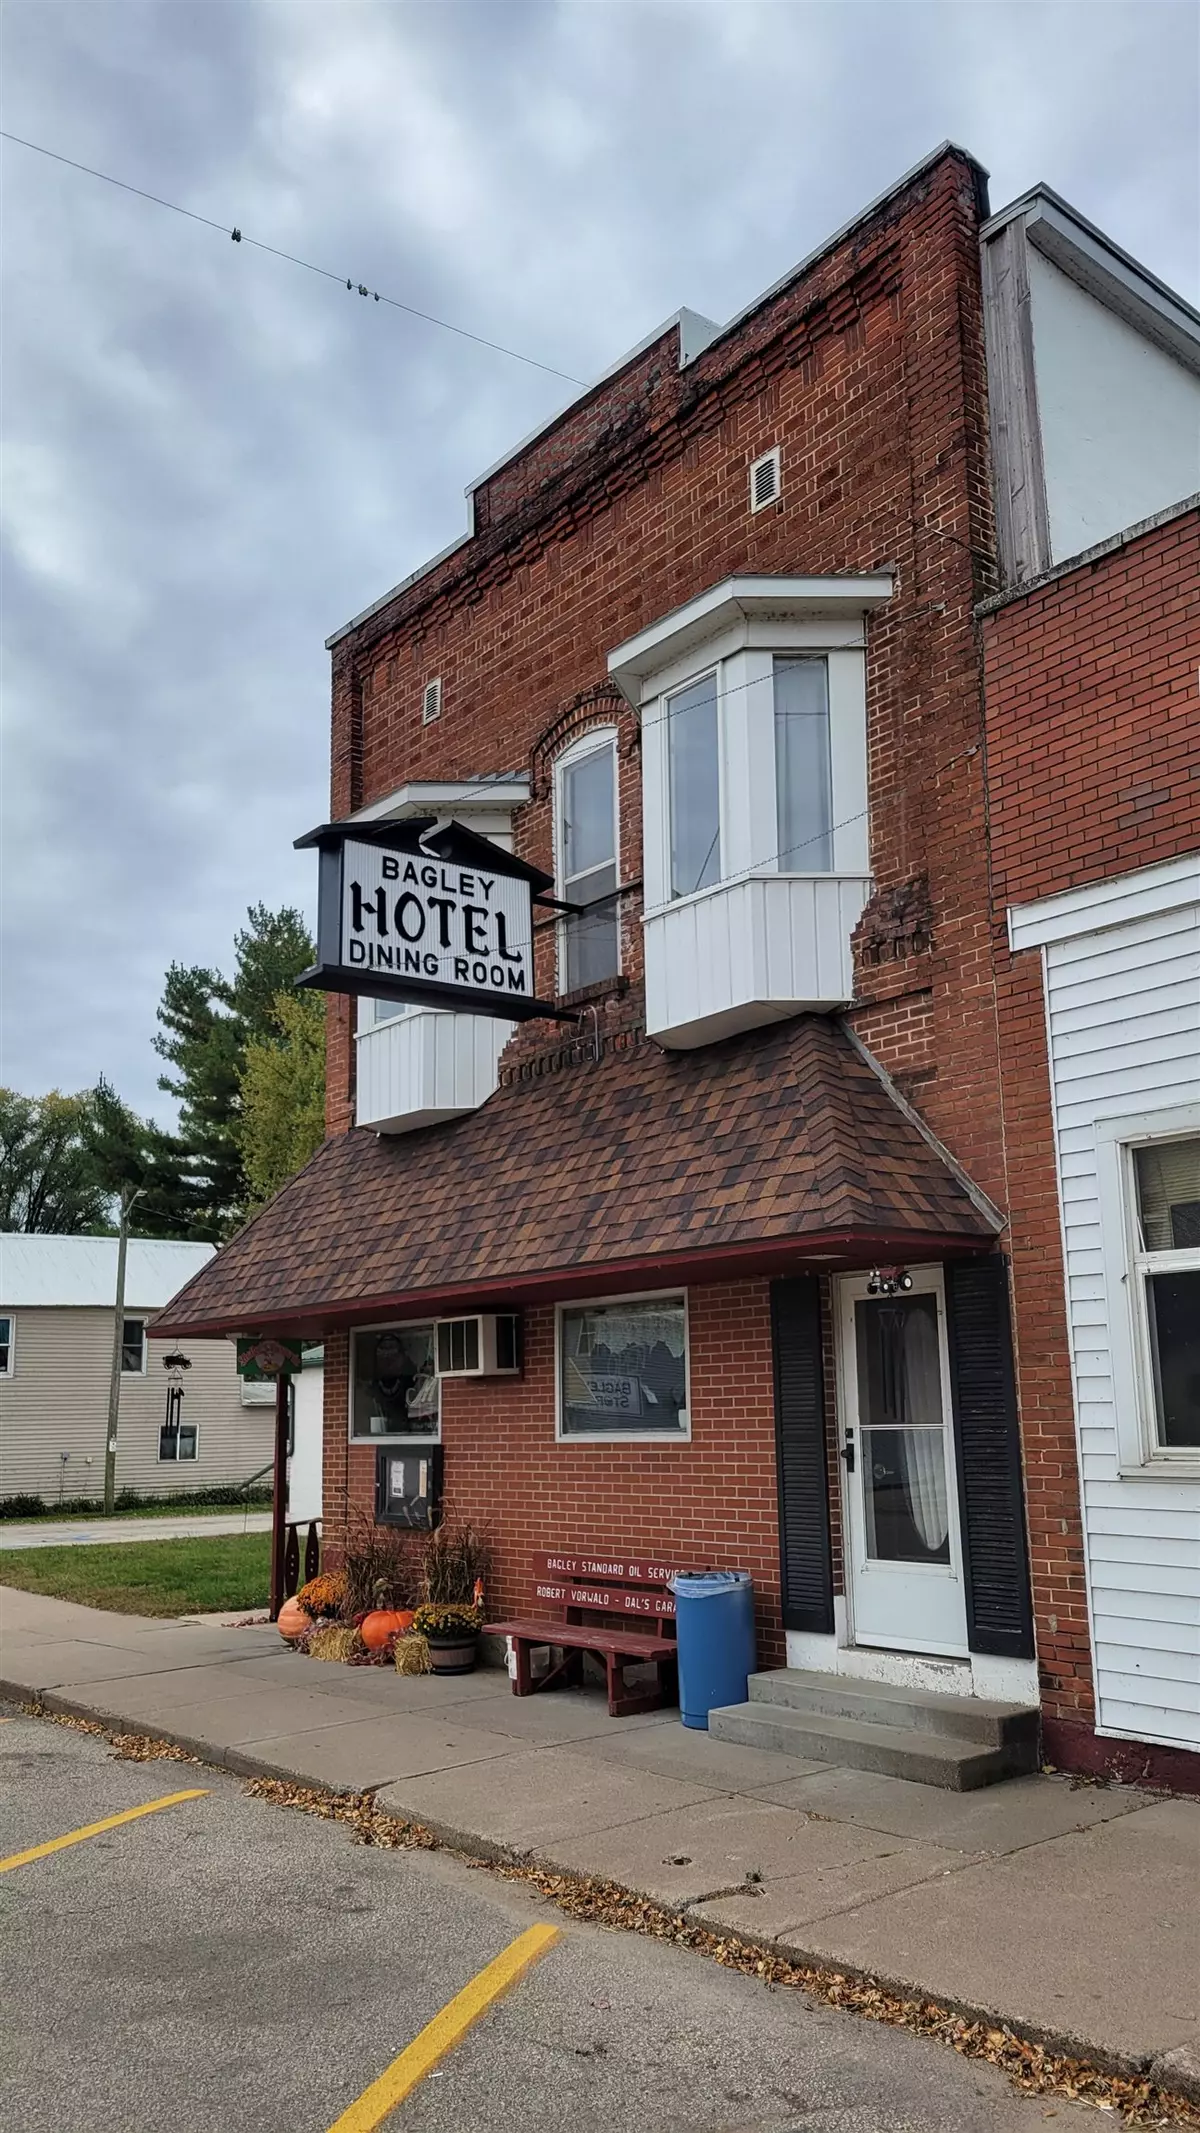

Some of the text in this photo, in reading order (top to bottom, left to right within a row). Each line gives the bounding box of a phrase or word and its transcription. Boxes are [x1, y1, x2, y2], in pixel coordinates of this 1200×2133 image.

[382, 855, 495, 901] BAGLEY
[349, 881, 523, 963] HOTEL
[349, 939, 526, 991] DINING ROOM
[547, 1558, 577, 1571] BAGLEY
[581, 1561, 624, 1576] STANDARD
[628, 1565, 642, 1578] OIL
[536, 1586, 566, 1599] ROBERT
[624, 1597, 650, 1610] DAL'S
